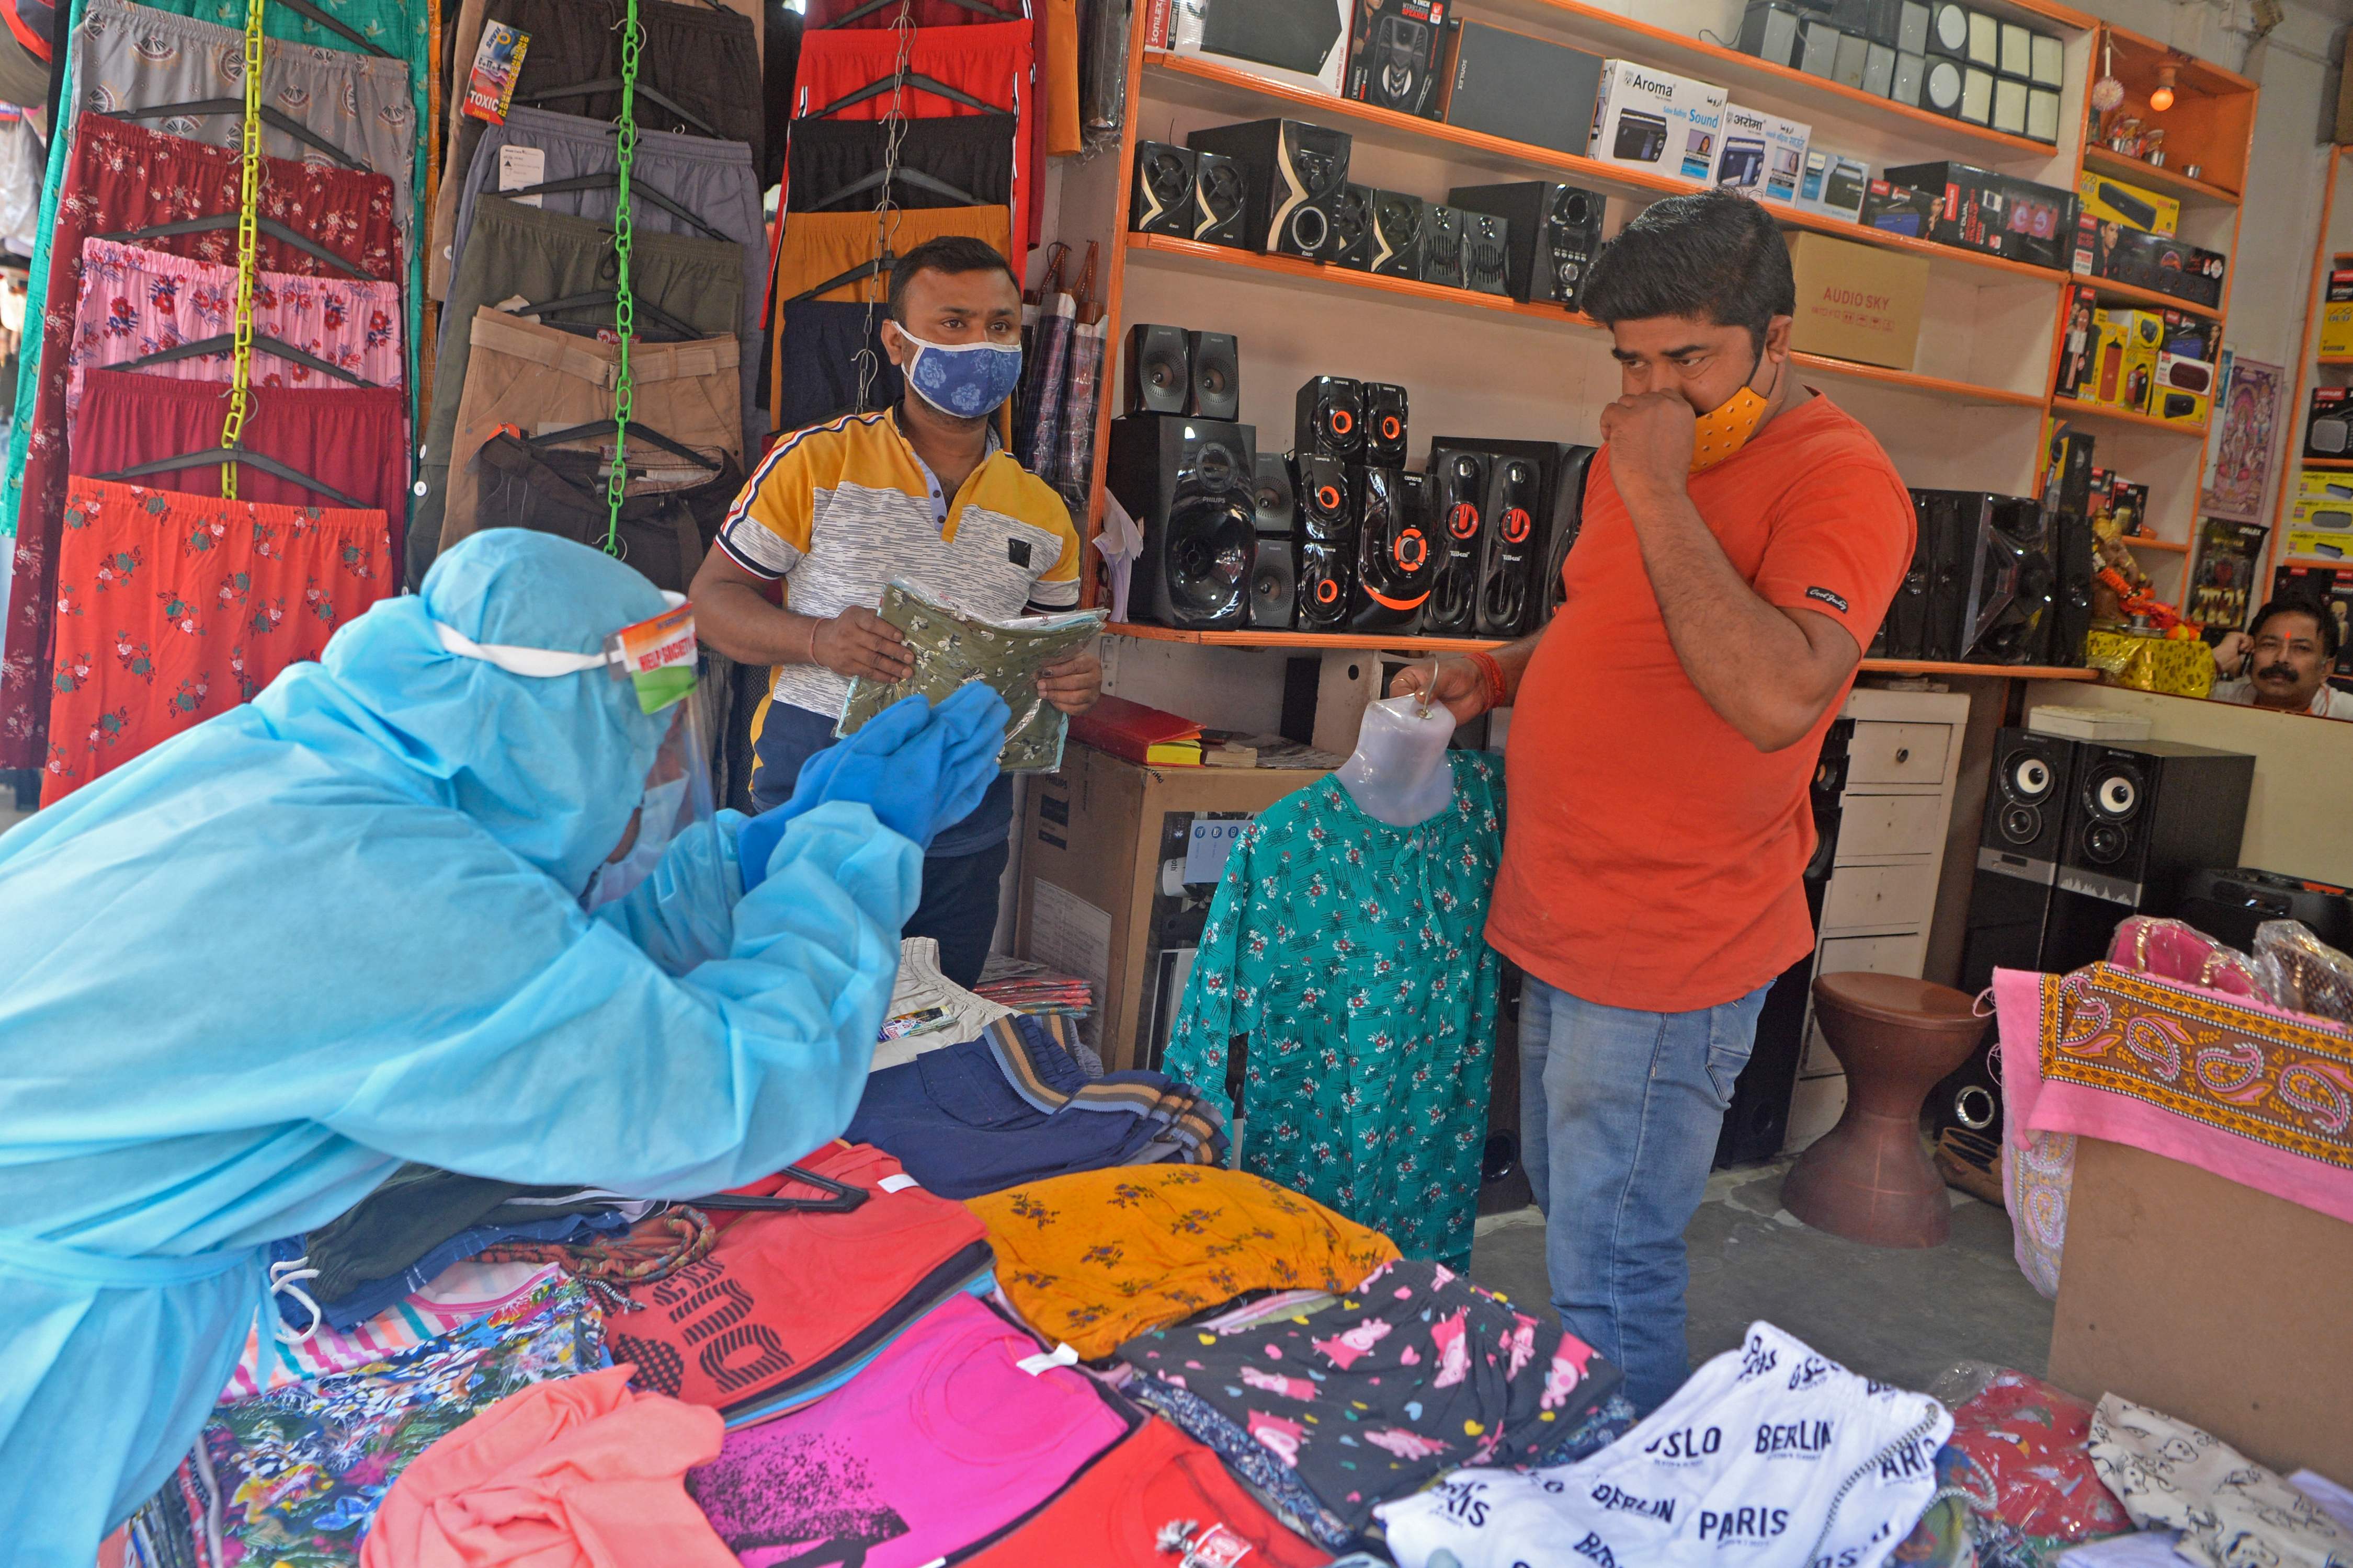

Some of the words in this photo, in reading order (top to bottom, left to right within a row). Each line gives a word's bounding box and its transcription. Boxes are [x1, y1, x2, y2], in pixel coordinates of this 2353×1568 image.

[1402, 8, 1428, 21] SPEAKER
[519, 34, 529, 43] 20
[1632, 75, 1673, 97] Aroma
[470, 90, 499, 112] TOXIC
[472, 108, 490, 120] Jeans
[1689, 109, 1719, 128] Sound
[1734, 114, 1763, 131] अरोमा
[1823, 287, 1863, 306] AUDIO
[1866, 295, 1891, 311] SKY
[1810, 589, 1829, 598] Cool
[1045, 774, 1067, 789] PHILIPS
[1755, 1419, 1834, 1455] BERLIN
[1699, 1507, 1789, 1541] PARIS
